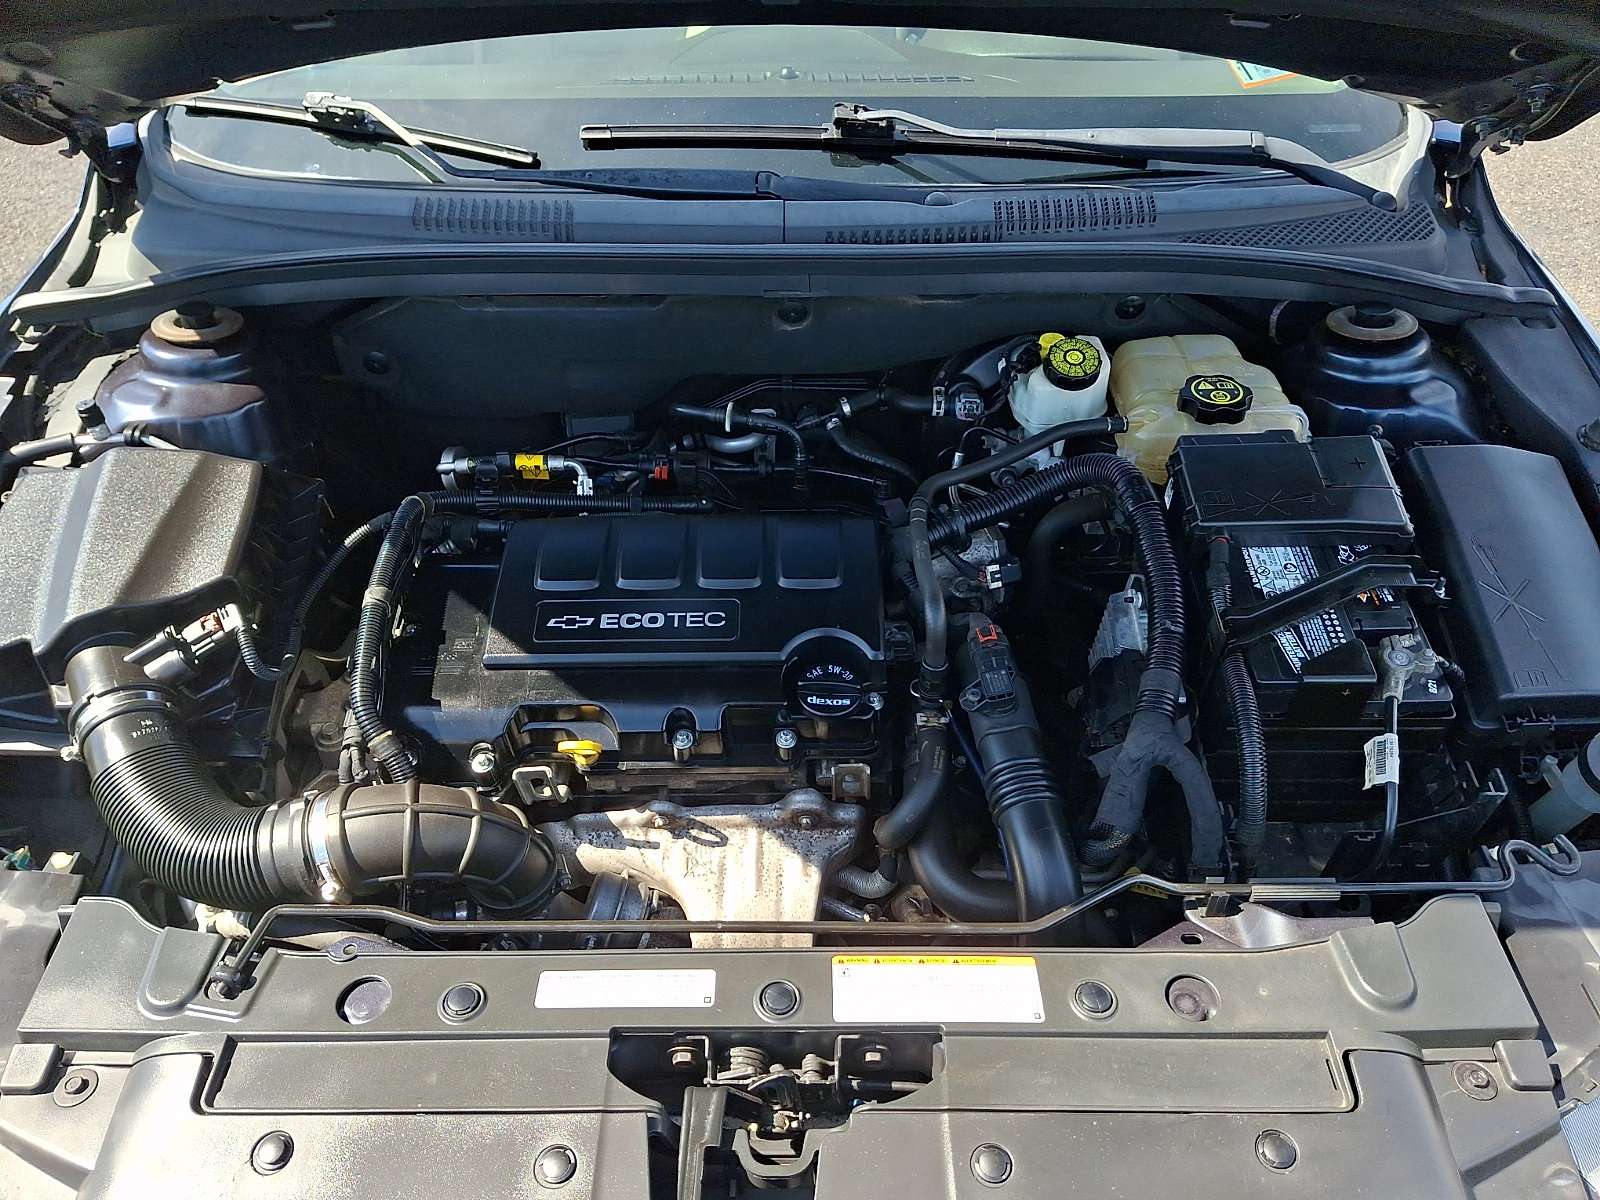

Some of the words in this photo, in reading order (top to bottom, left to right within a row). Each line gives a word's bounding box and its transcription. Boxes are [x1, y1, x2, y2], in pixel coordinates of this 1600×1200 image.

[599, 611, 727, 629] ECOTEC
[1283, 631, 1305, 658] BATTERY
[806, 666, 824, 679] SAE
[827, 664, 854, 681] 5W-30
[807, 695, 851, 706] dexos
